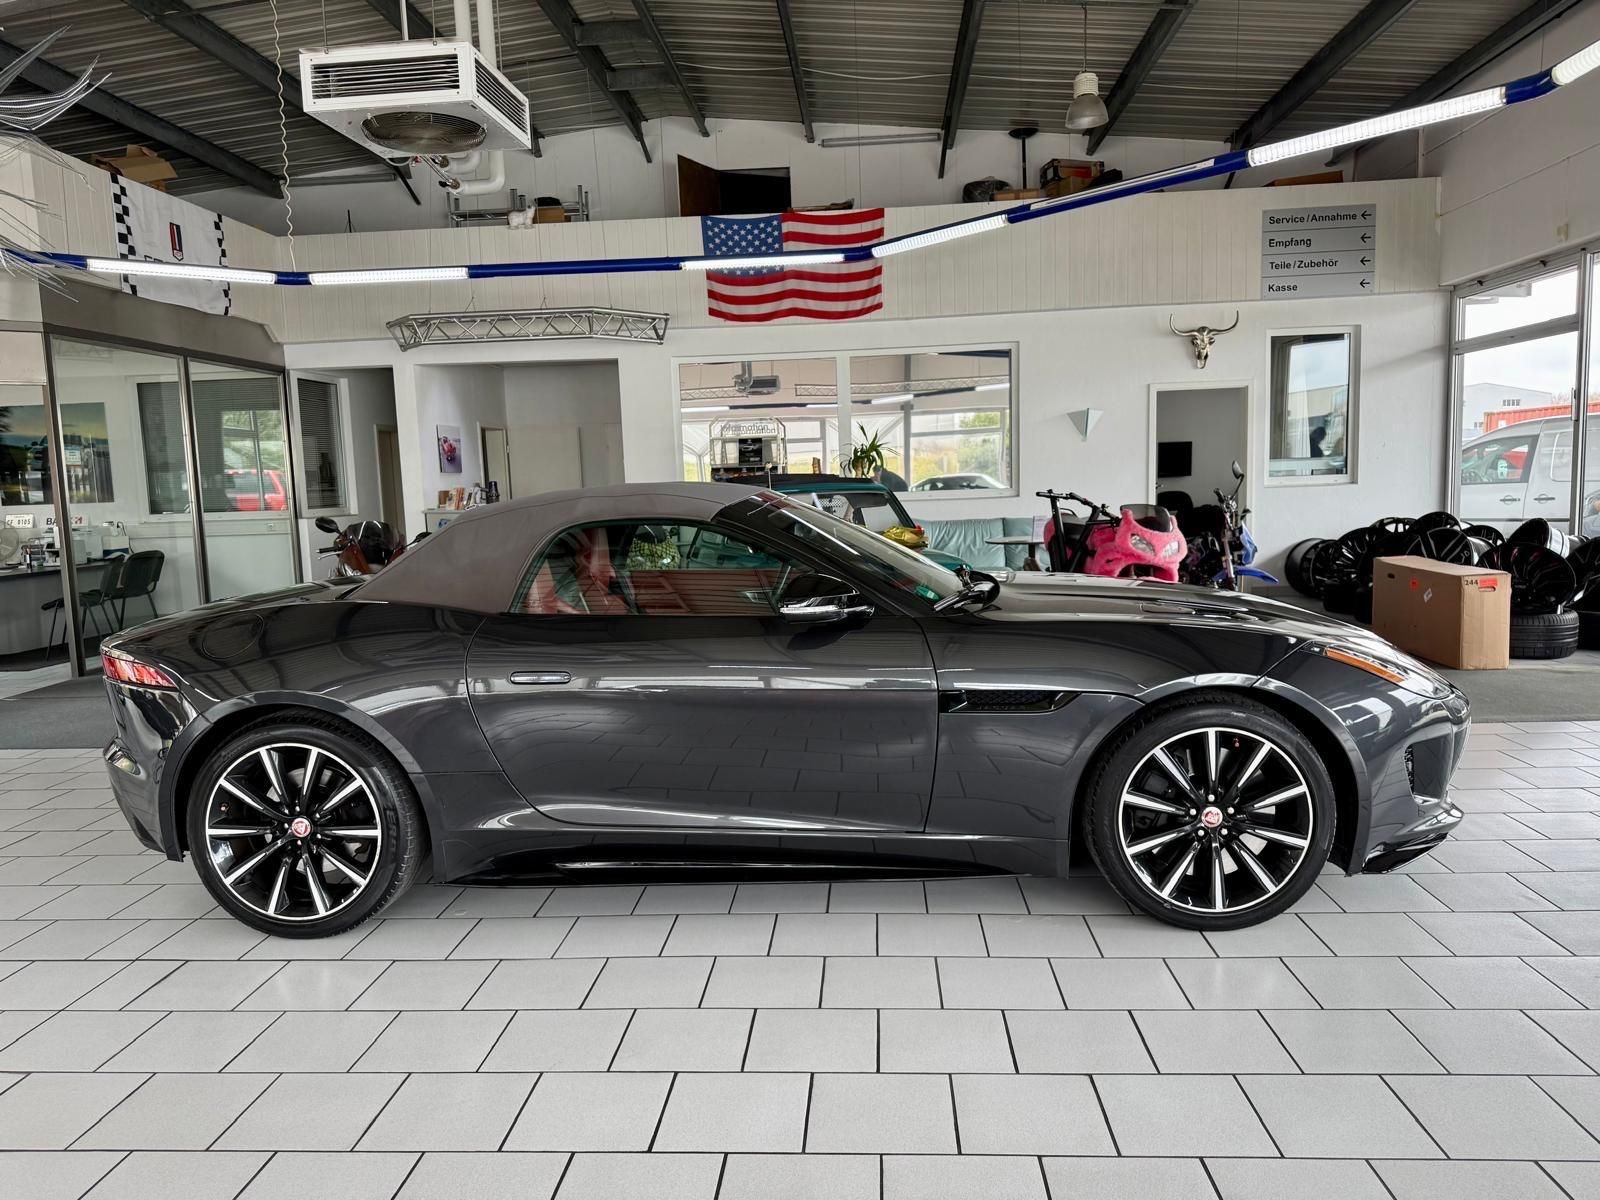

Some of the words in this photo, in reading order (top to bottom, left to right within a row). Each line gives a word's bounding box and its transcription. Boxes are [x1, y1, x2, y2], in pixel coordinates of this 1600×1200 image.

[1268, 237, 1312, 249] Empfang
[1269, 258, 1339, 270] Teile/Zubehör
[1268, 283, 1298, 292] Kasse
